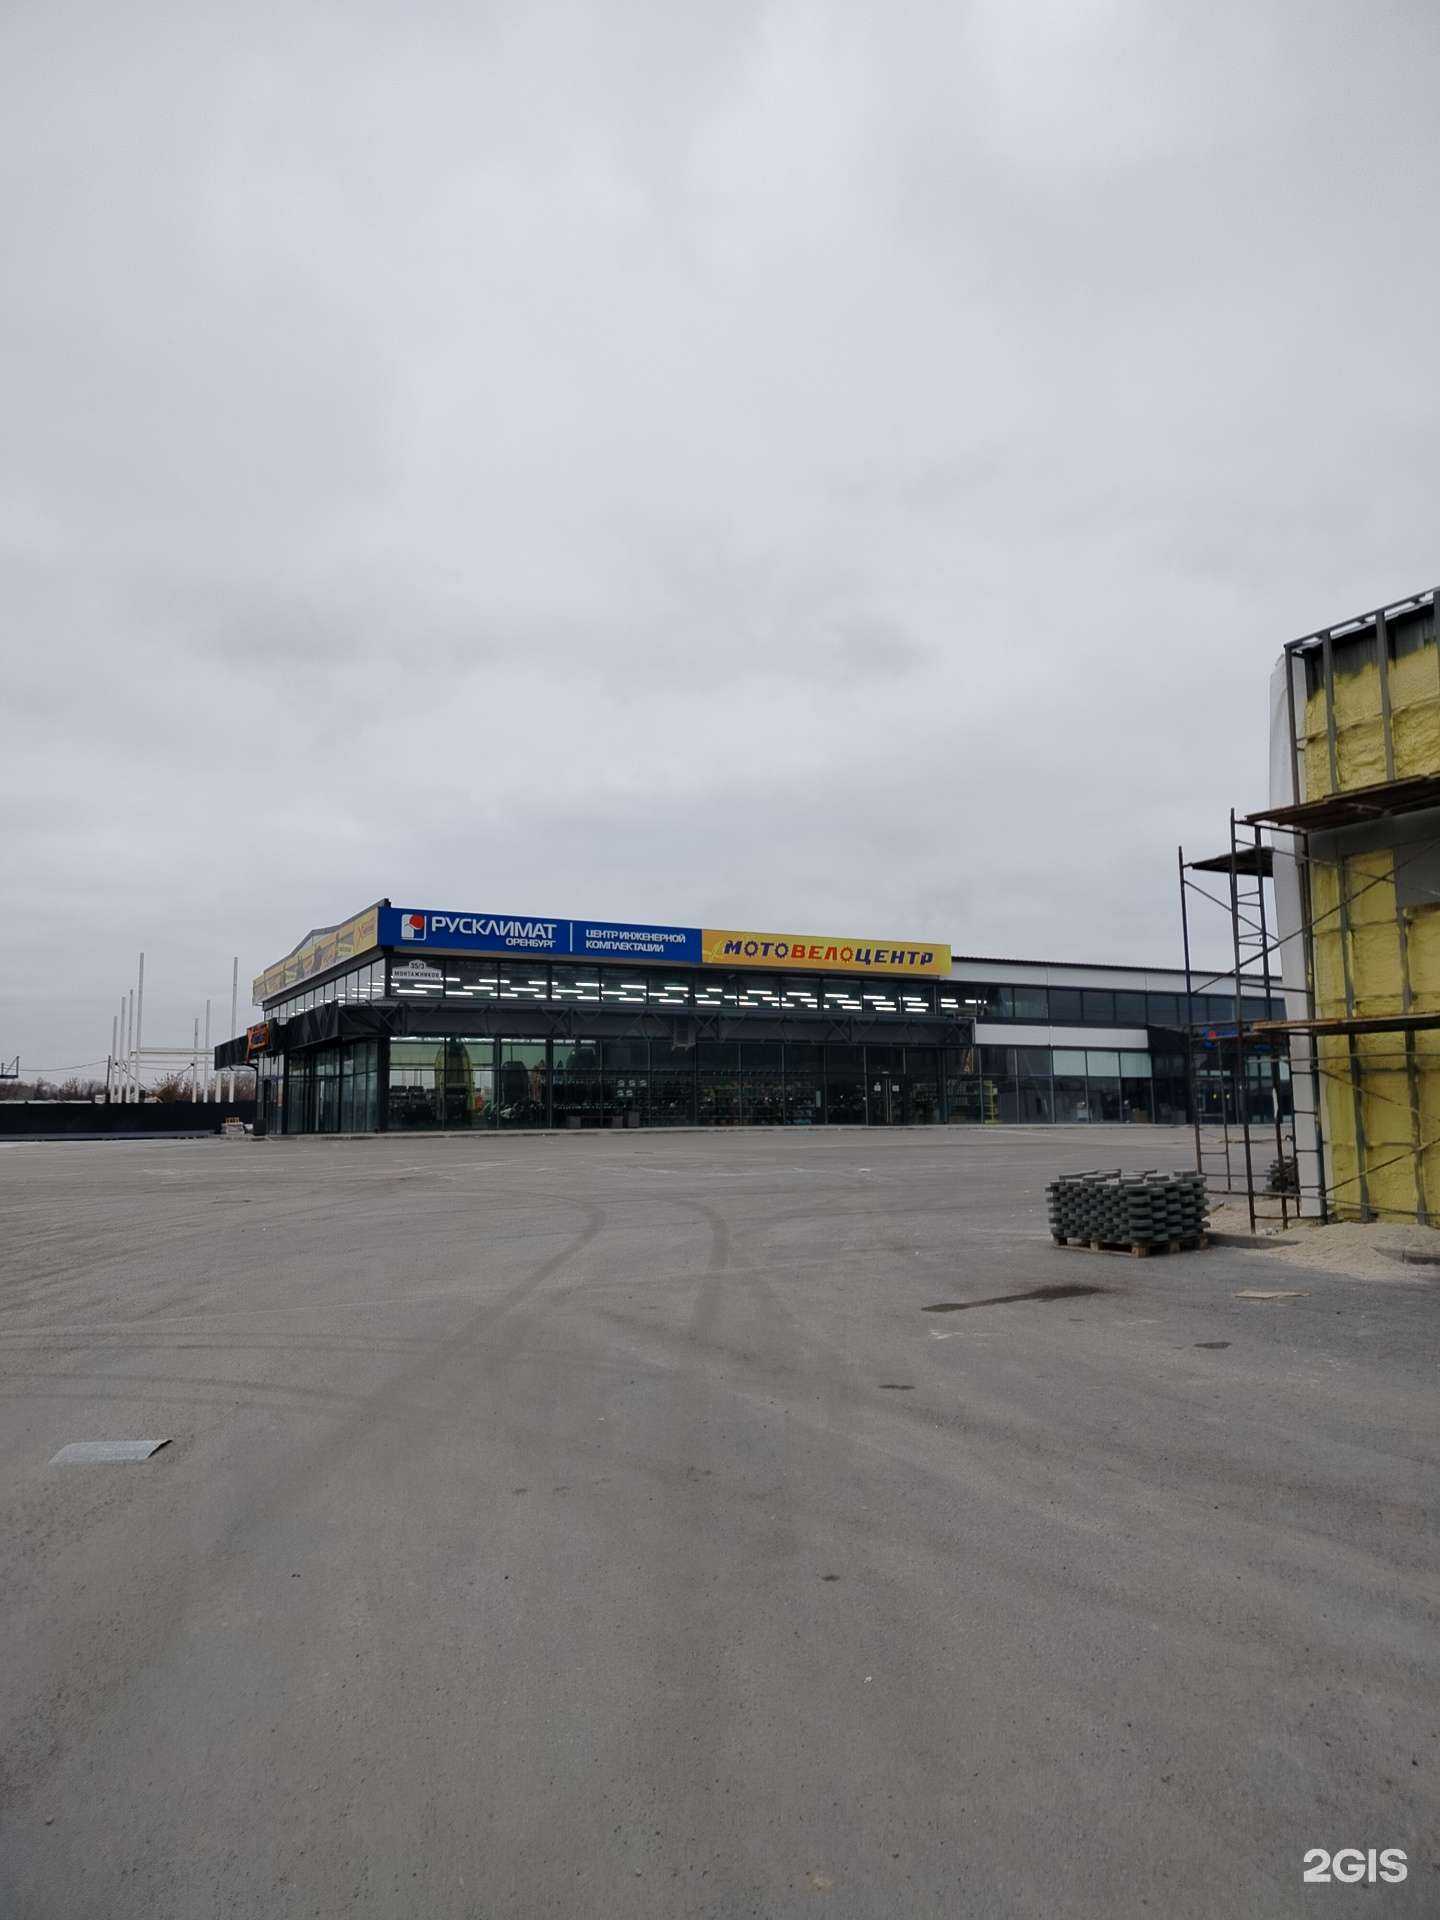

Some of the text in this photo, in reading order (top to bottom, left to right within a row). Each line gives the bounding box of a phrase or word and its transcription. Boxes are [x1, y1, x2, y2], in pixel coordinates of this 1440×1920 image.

[431, 916, 557, 938] РУСКЛИМАТ
[505, 937, 556, 948] ОРЕНБУРГ
[585, 929, 686, 943] ЦЕНТР ИНЖЕНЕРНОЙ
[585, 940, 664, 952] КОМПЛЕКТАЦИИ
[723, 939, 933, 966] МОТОВЕЛОЦЕНТР
